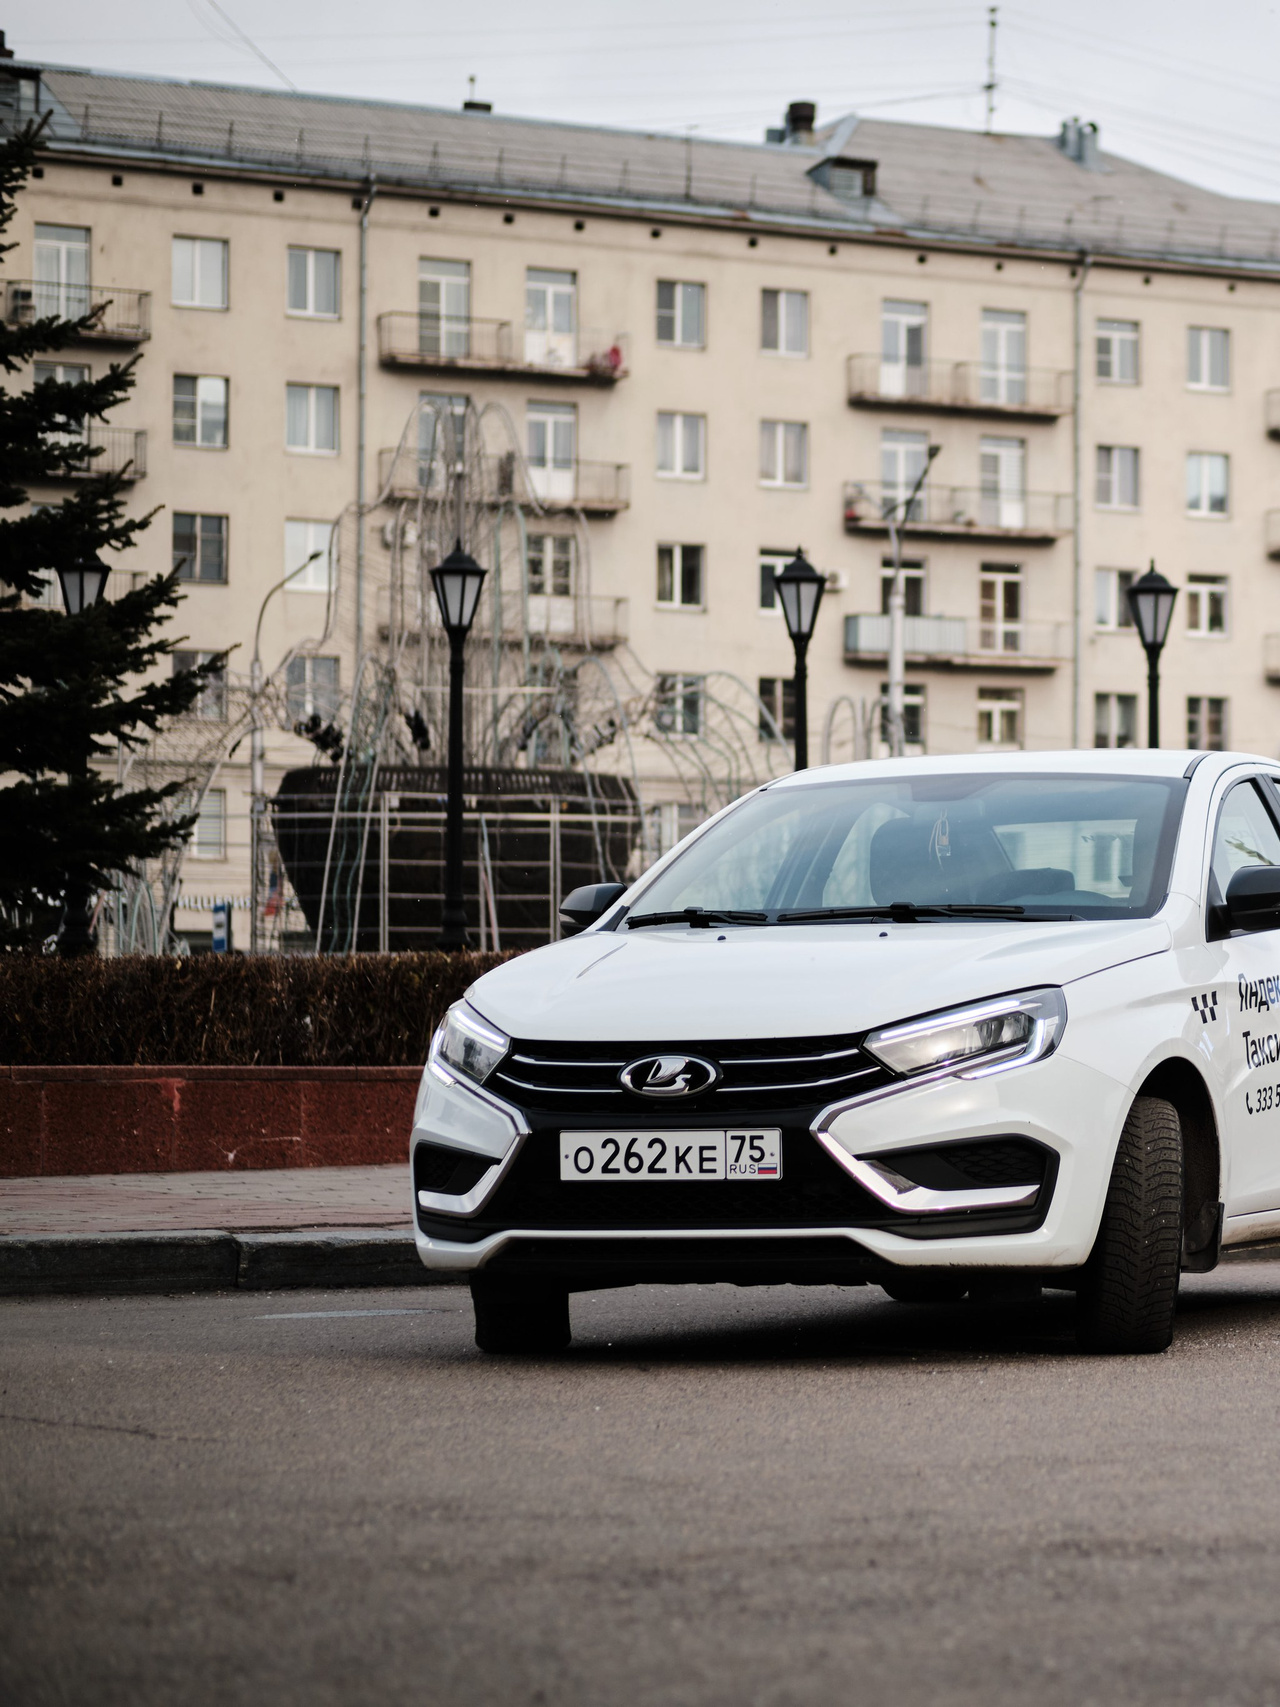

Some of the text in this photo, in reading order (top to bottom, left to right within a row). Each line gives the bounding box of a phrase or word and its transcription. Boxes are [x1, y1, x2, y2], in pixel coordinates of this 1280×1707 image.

[1255, 1086, 1273, 1113] 333
[730, 1135, 765, 1163] 75
[729, 1163, 756, 1174] RUS
